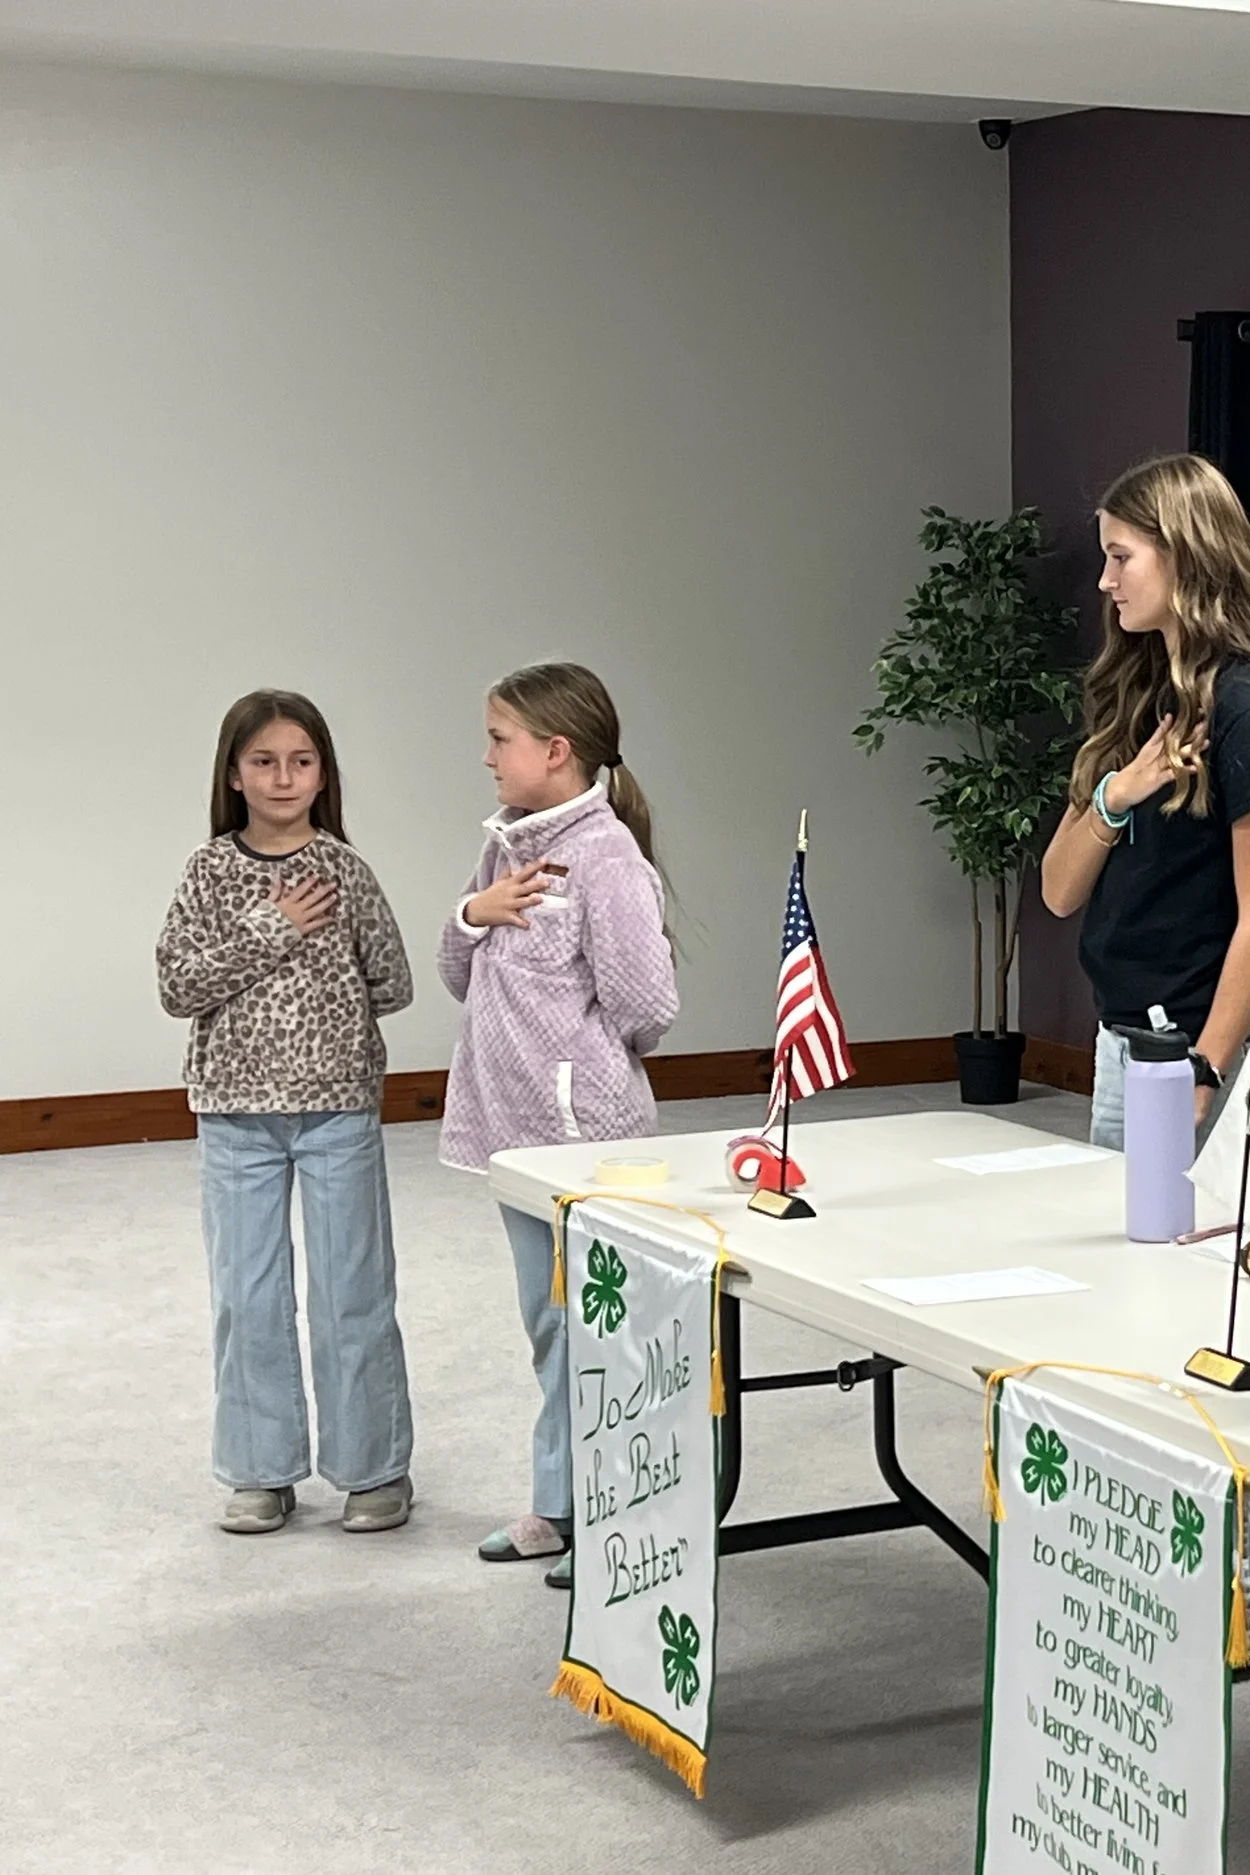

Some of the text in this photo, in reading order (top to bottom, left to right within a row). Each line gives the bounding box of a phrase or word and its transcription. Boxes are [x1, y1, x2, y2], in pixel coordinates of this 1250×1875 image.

[624, 1318, 692, 1420] Make
[586, 1431, 681, 1527] the Best
[1072, 1459, 1165, 1534] I PLEDGE
[1033, 1533, 1056, 1566] to
[1061, 1547, 1115, 1597] clearer
[1069, 1511, 1161, 1576] my HEAD
[1036, 1619, 1057, 1652] to
[1063, 1638, 1121, 1686] greater
[1063, 1593, 1159, 1665] my HEART
[1054, 1676, 1157, 1754] my HANDS
[1043, 1705, 1094, 1756] larger
[1157, 1781, 1187, 1819] and
[1012, 1813, 1041, 1852] my
[1046, 1757, 1159, 1848] my HEALTH
[1051, 1794, 1102, 1849] better
